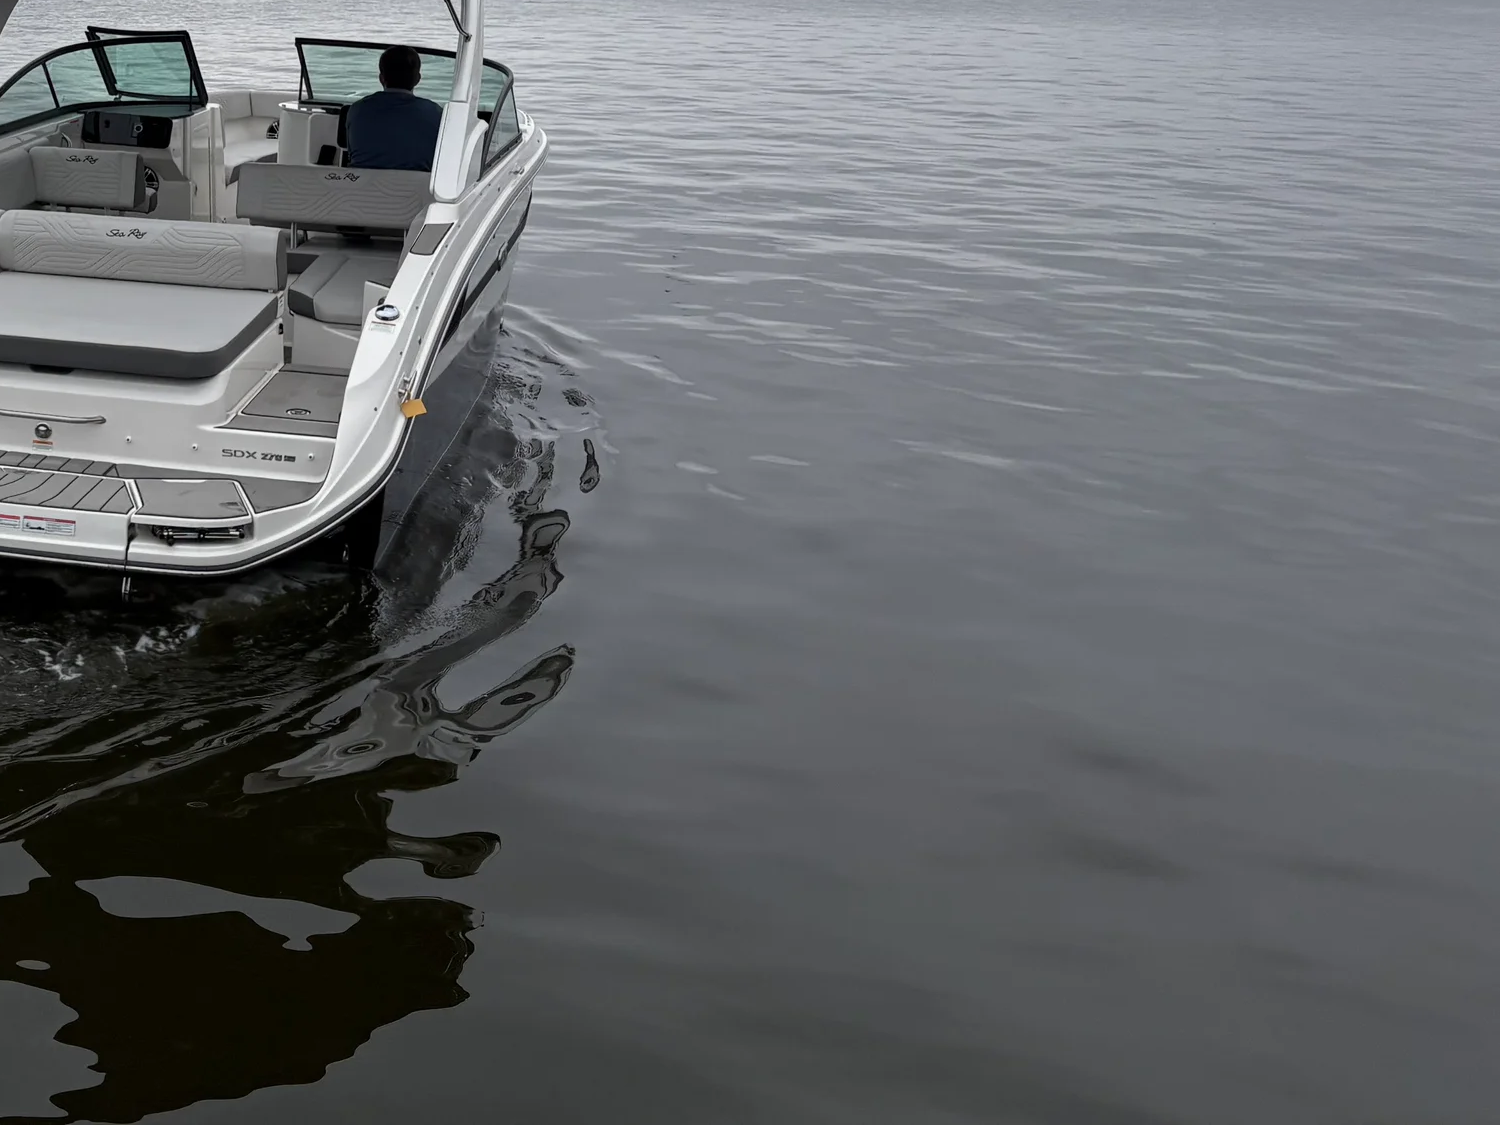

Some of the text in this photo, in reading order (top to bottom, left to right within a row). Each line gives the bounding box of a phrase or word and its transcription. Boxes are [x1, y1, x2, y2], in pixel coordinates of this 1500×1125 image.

[105, 228, 147, 239] Sea Ray
[221, 448, 257, 459] SDX
